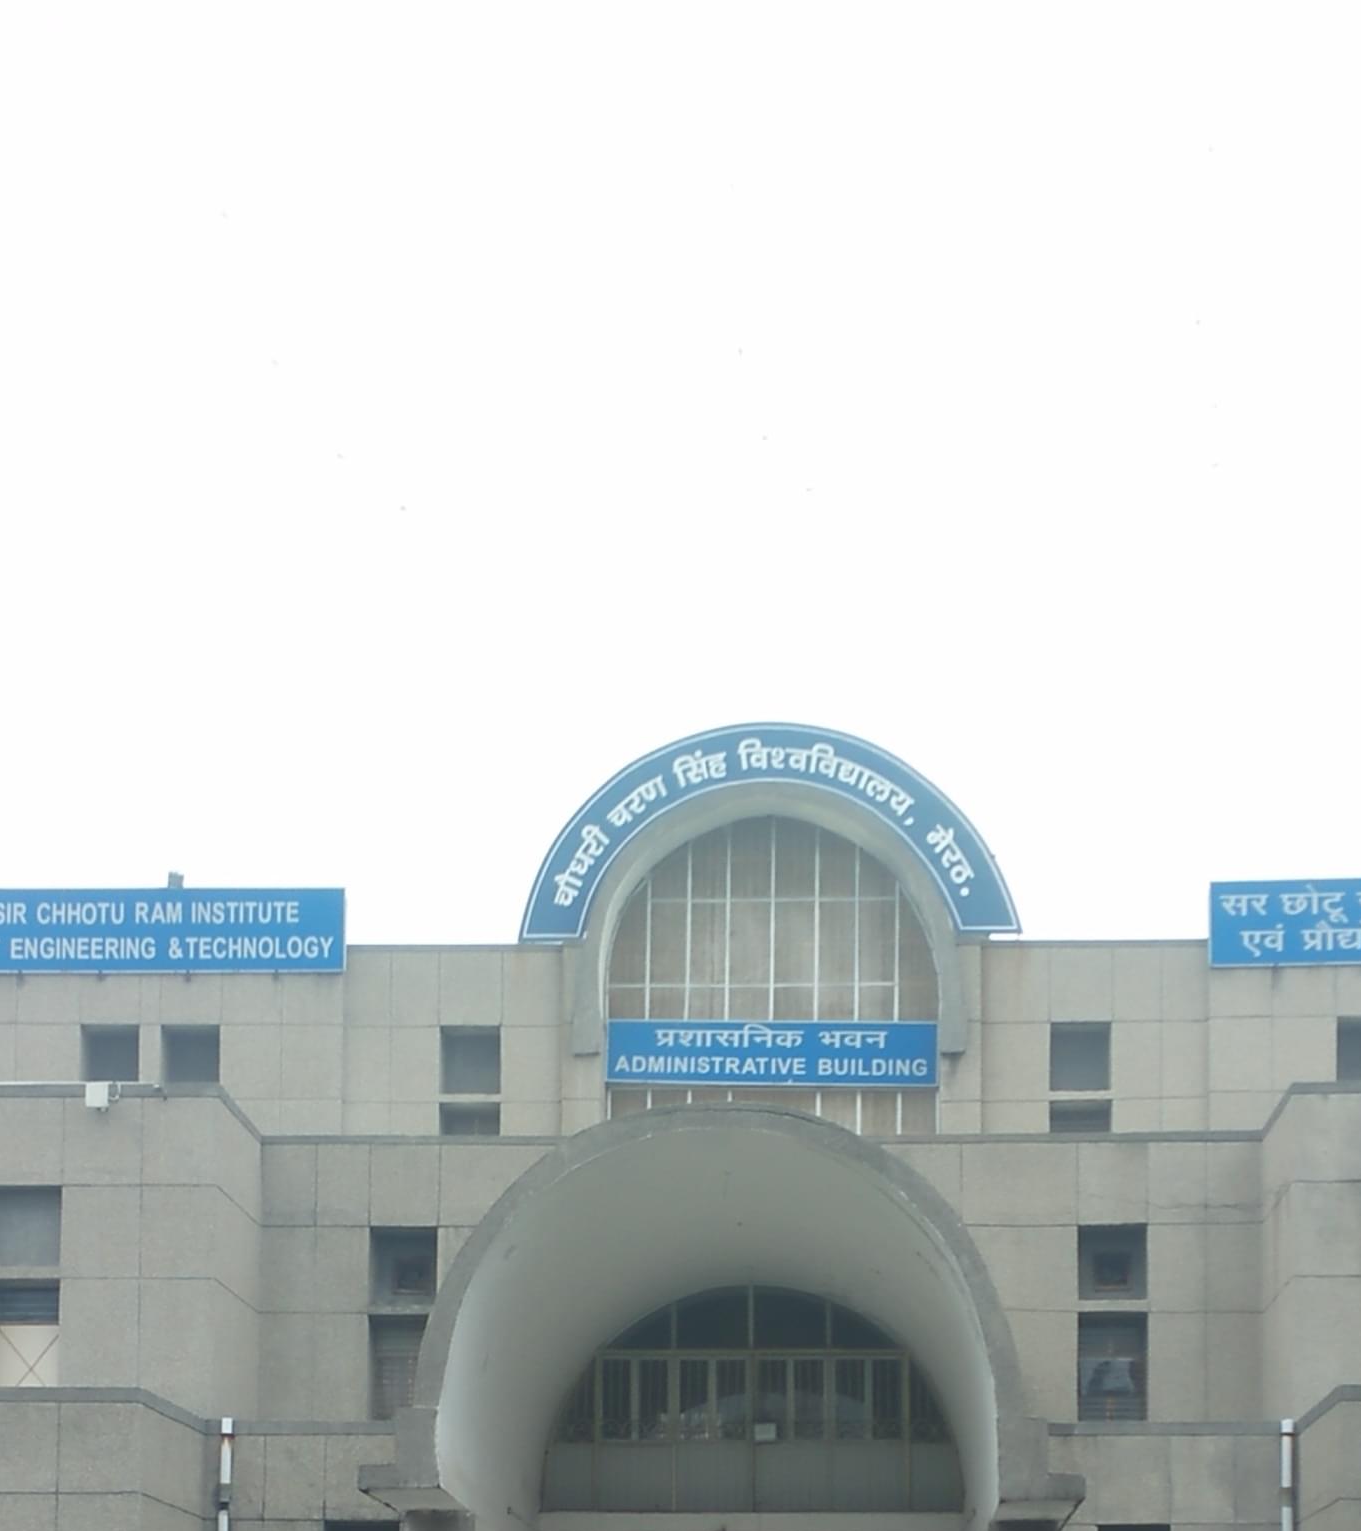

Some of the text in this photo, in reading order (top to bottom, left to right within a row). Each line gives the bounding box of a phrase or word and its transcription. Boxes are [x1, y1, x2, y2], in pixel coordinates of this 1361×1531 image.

[606, 774, 668, 828] चरण
[672, 751, 728, 788] सिंह
[36, 901, 125, 925] CHHOTU
[135, 901, 183, 924] RAM
[191, 900, 300, 924] INSTITUTE
[1219, 892, 1269, 916] सर
[1279, 884, 1349, 923] छोटू
[10, 936, 156, 960] ENGINEERING
[1239, 923, 1286, 957] एवं
[655, 1023, 888, 1049] प्रशासनिक भवन
[614, 1055, 928, 1077] ADMINISTRATIVE BUILDING
